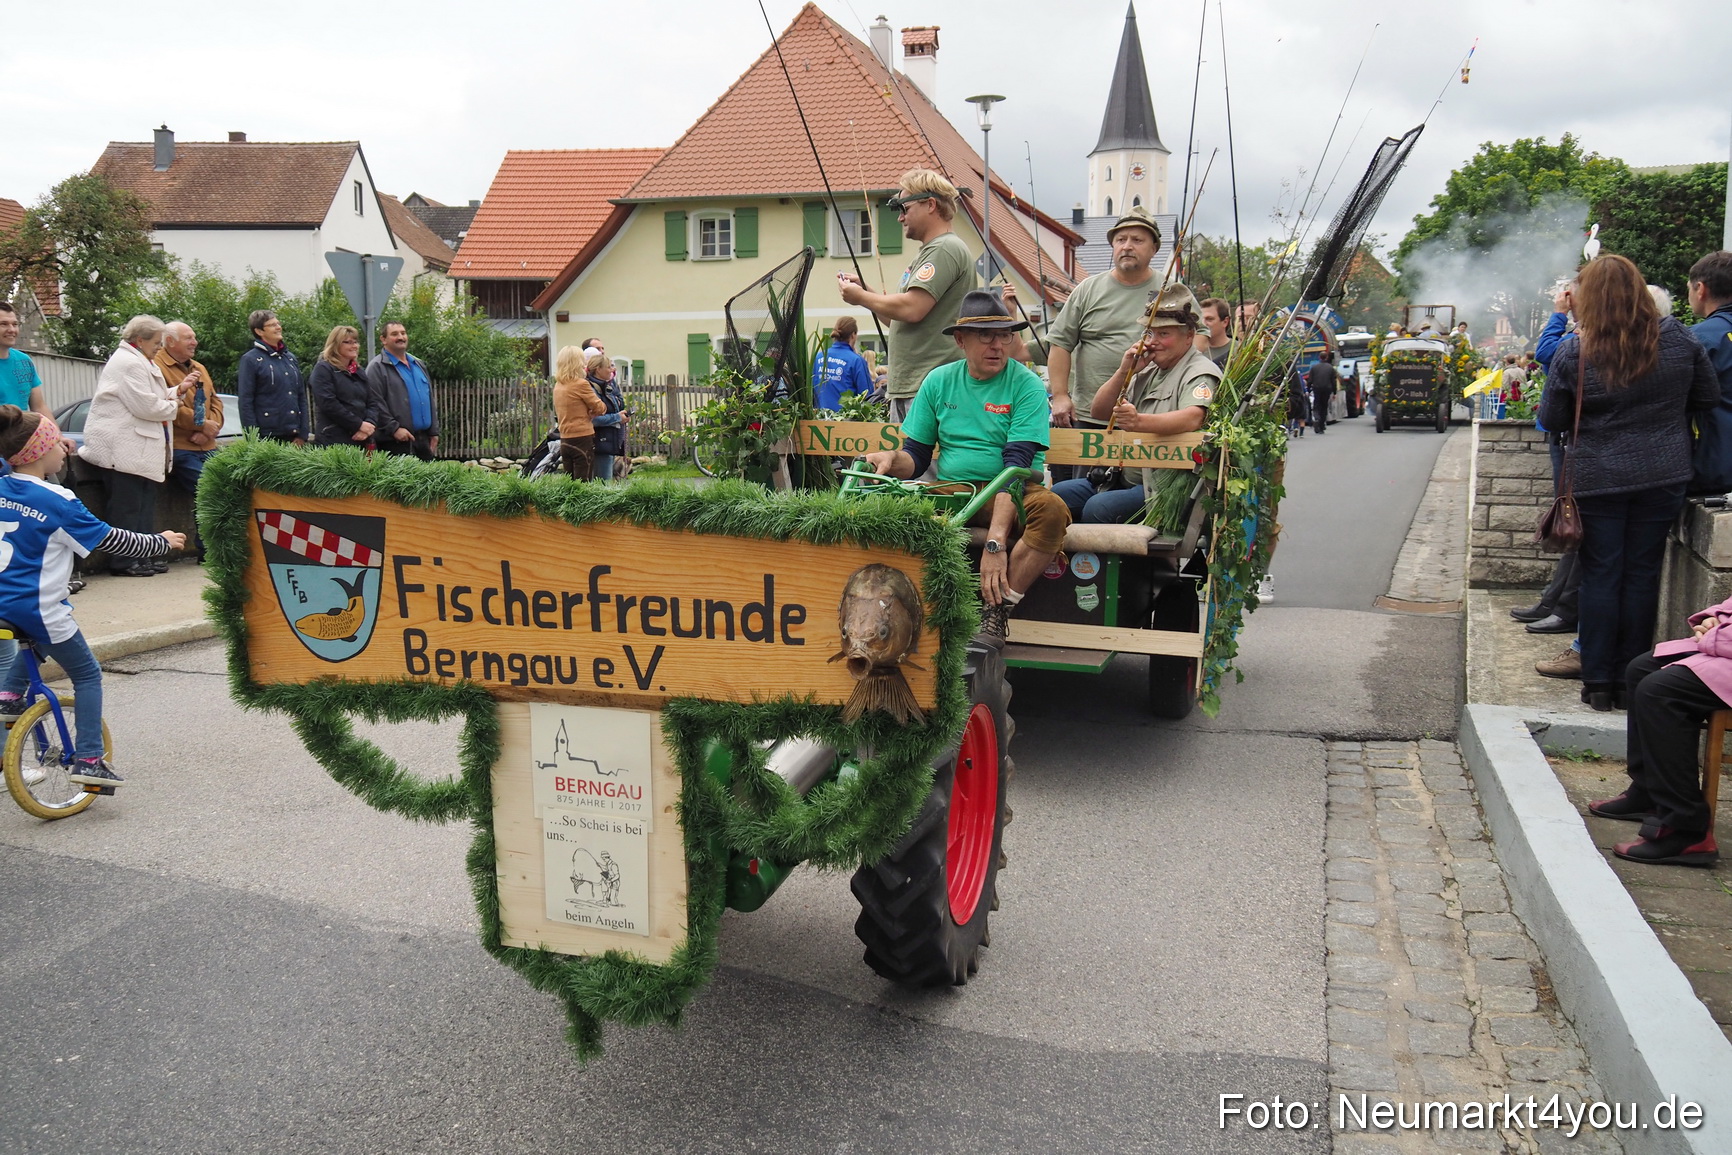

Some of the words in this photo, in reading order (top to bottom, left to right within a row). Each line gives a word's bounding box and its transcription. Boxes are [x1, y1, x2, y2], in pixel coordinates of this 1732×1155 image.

[818, 366, 836, 374] Alianz
[0, 497, 48, 522] Berngau
[392, 555, 807, 645] Fischerfreunde
[403, 627, 578, 686] Berngau
[592, 645, 666, 691] e.V.
[555, 776, 642, 800] BERNGAU
[556, 794, 574, 804] 875
[576, 798, 606, 808] JAHRE
[618, 801, 642, 812] 2017
[579, 817, 609, 832] Schei
[613, 821, 622, 833] is
[625, 823, 642, 836] bei
[565, 909, 592, 923] beim
[595, 915, 635, 930] Angeln
